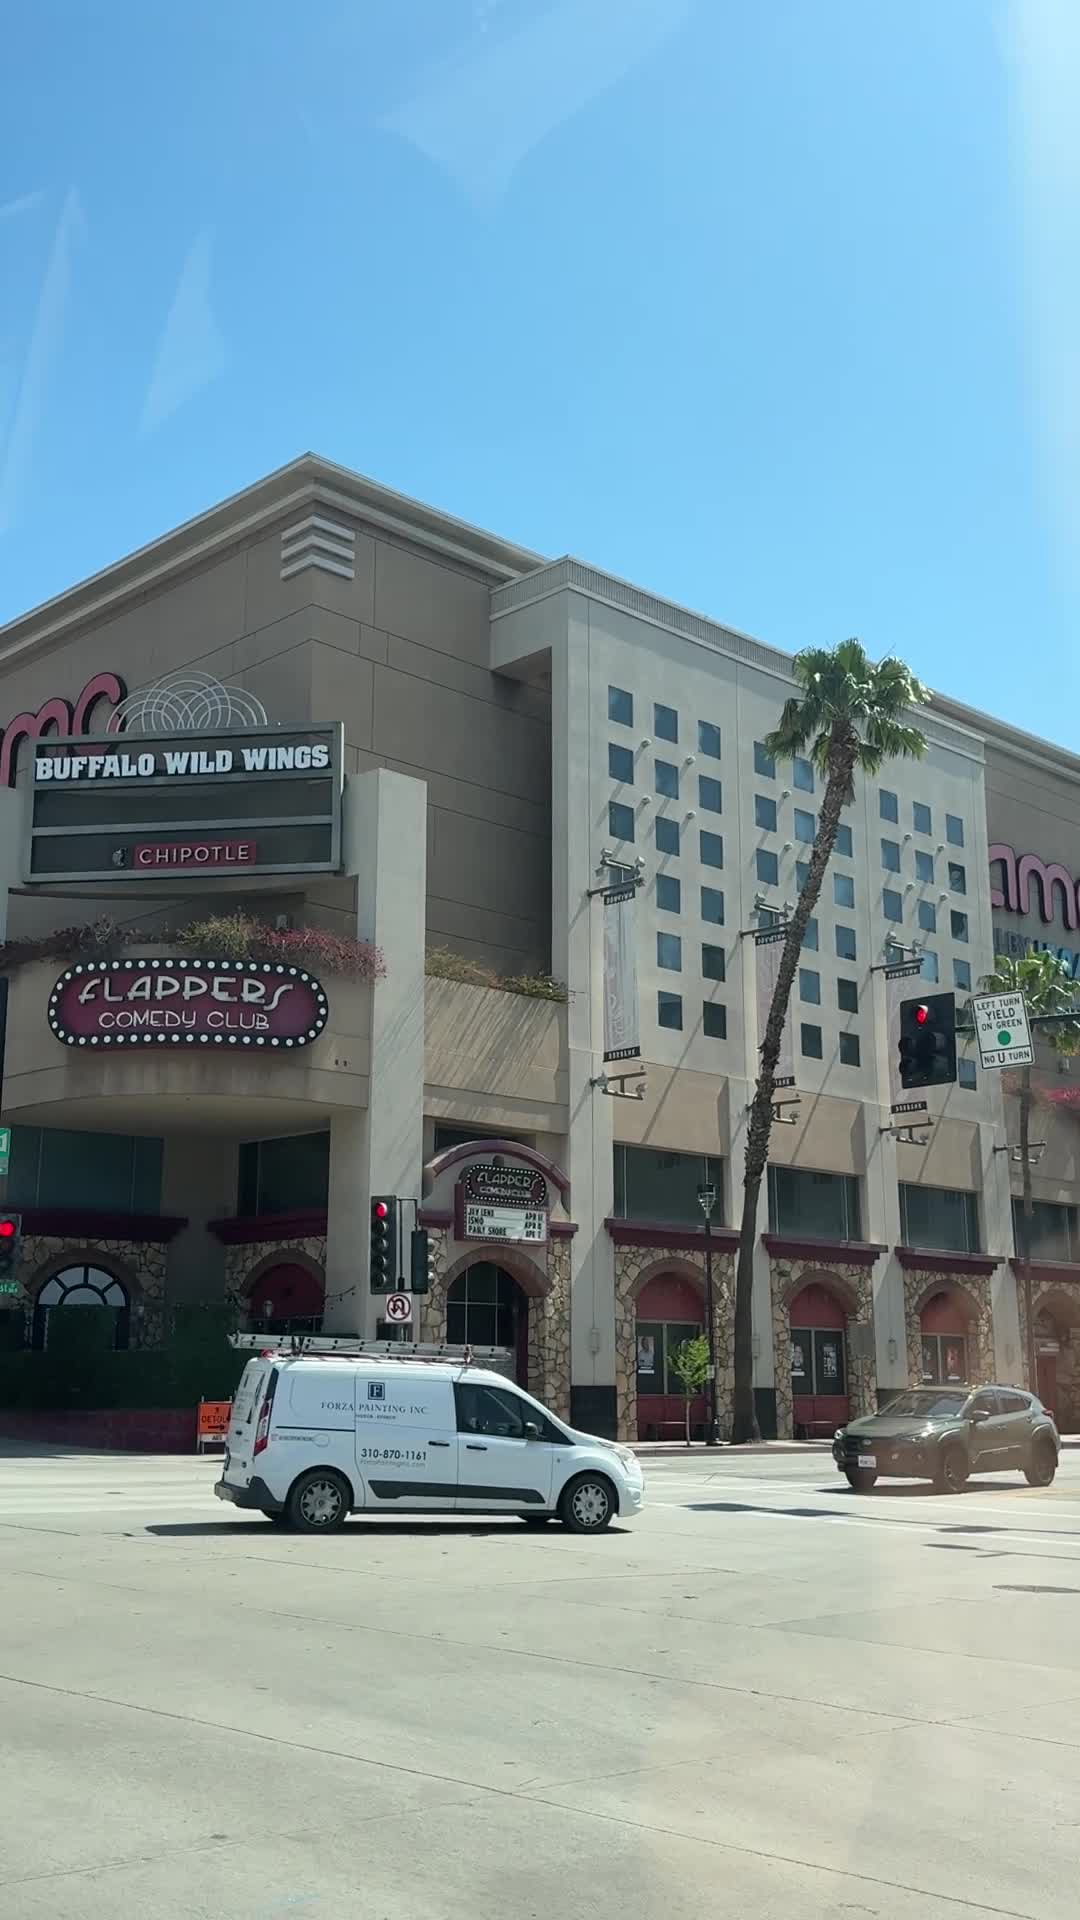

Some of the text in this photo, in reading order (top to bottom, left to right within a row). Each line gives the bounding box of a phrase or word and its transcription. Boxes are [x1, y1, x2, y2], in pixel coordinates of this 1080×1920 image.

[35, 744, 329, 780] BUFFALO WILD WINGS
[139, 845, 249, 865] CHIPOTLE
[78, 975, 294, 1011] FLAPPERS
[976, 997, 1020, 1011] LEFT TURN
[99, 1010, 270, 1030] COMEDY CLUB
[984, 1007, 1016, 1021] YIELD
[981, 1018, 1023, 1031] ON GREEN
[983, 1051, 1030, 1064] NO U TURN
[477, 1171, 538, 1191] FLAPPERS
[320, 1401, 429, 1415] FORZA PAINTING INC
[360, 1448, 427, 1461] 310-870-1161
